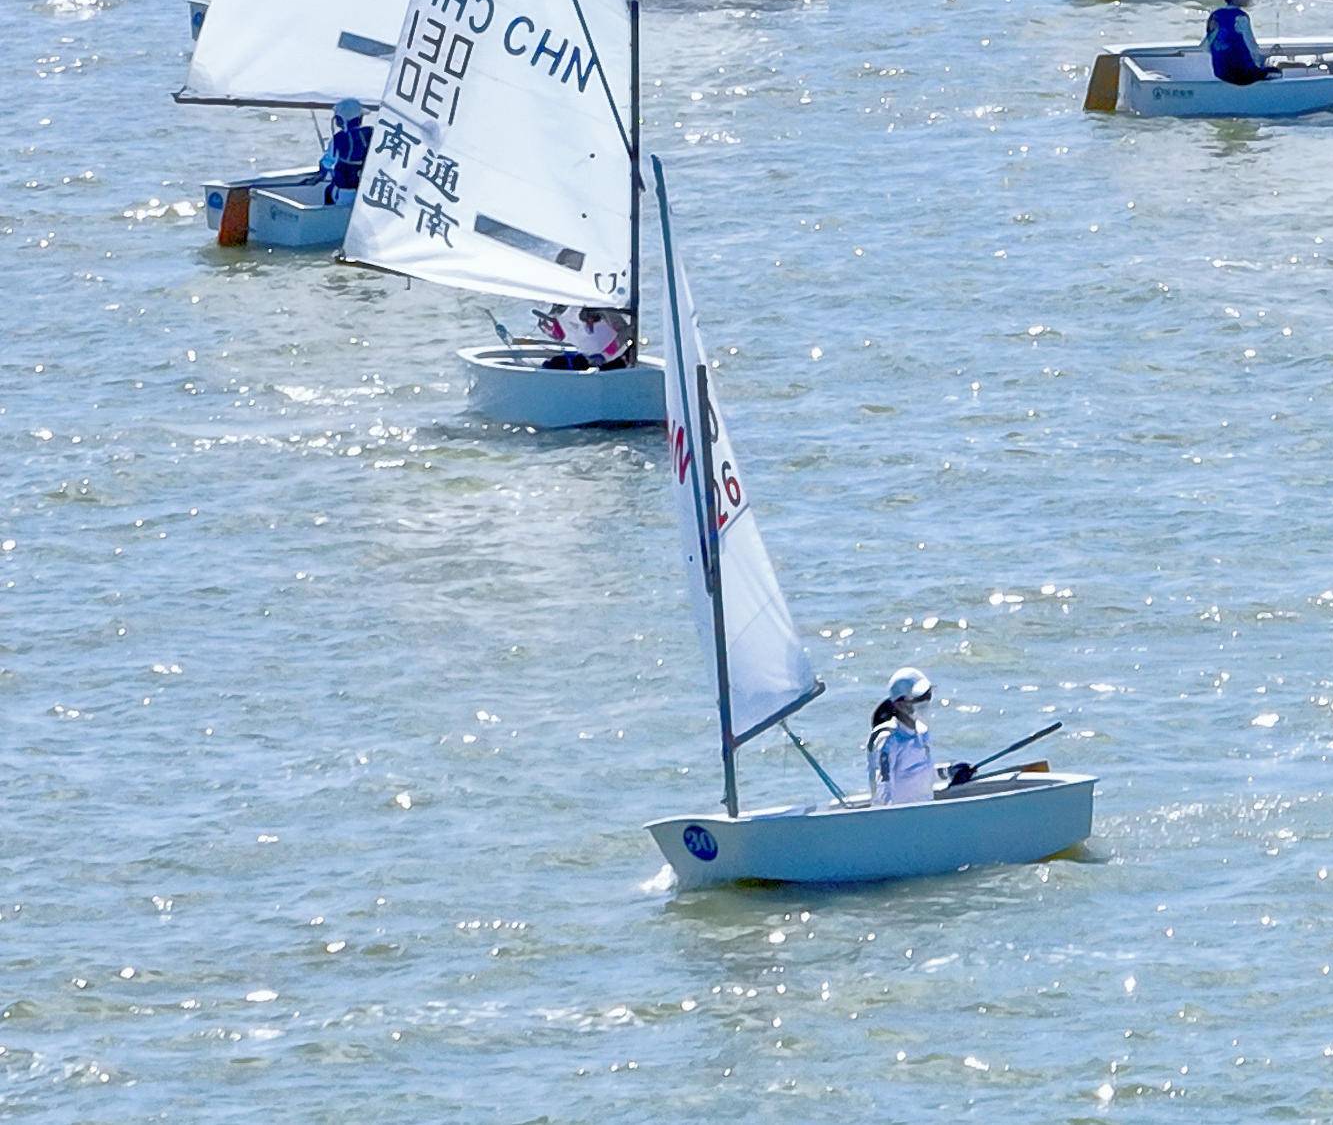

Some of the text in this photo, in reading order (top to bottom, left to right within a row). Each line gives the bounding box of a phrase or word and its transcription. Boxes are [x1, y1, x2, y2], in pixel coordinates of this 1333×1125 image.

[407, 10, 474, 80] 130
[504, 16, 597, 92] CHN
[375, 118, 459, 202] 南通
